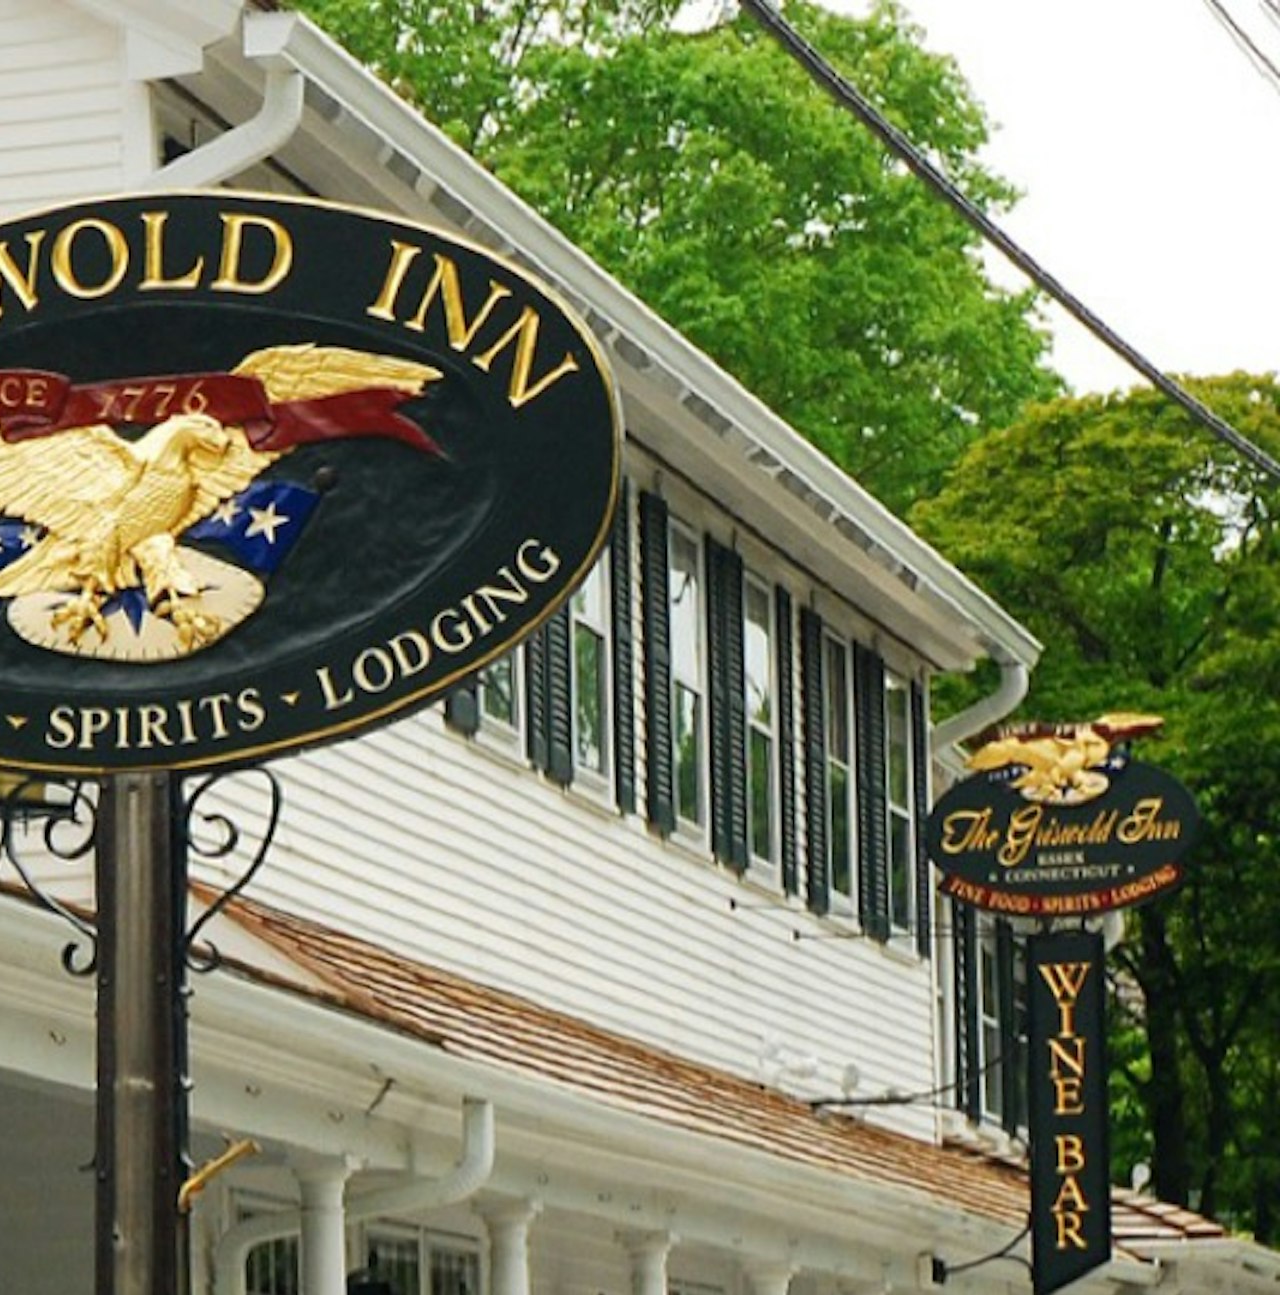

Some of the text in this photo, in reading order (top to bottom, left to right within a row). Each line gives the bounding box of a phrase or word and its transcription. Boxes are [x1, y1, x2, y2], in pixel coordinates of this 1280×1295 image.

[366, 240, 582, 412] INN
[96, 380, 208, 422] 1776
[44, 686, 267, 750] SPIRITS
[315, 538, 562, 711] LODGING
[942, 796, 1180, 867] The Griswold Inn
[1005, 863, 1122, 884] CONNECTICUT
[949, 862, 1178, 913] FINE FOOD SPIRITS LODGING
[1038, 961, 1091, 1116] WINE
[1051, 1135, 1089, 1250] BAR
